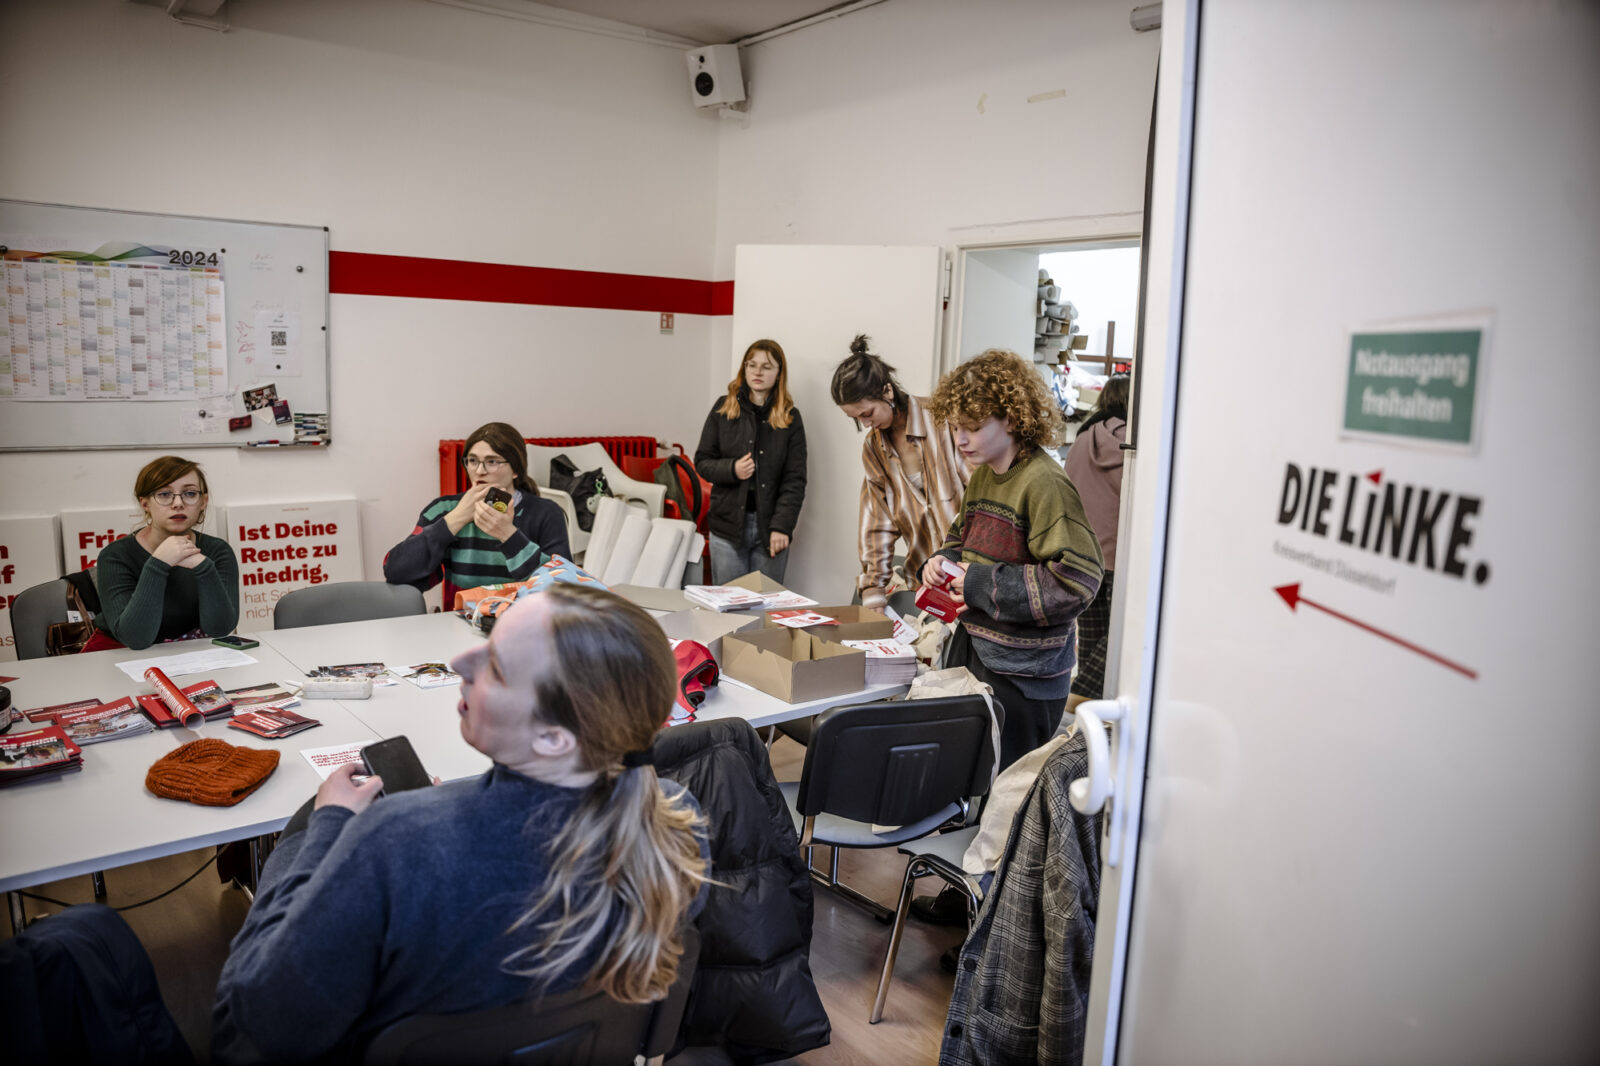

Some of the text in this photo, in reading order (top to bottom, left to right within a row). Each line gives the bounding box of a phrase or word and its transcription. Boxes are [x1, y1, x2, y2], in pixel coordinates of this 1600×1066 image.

[168, 250, 219, 267] 2024
[1355, 348, 1471, 387] Notausgang
[1361, 385, 1453, 423] freihalten
[1276, 461, 1338, 539] DIE
[239, 520, 338, 542] Ist Deine
[240, 544, 337, 564] Rente zu
[243, 563, 329, 587] niedrig,
[244, 591, 267, 604] hat
[246, 605, 275, 619] nich
